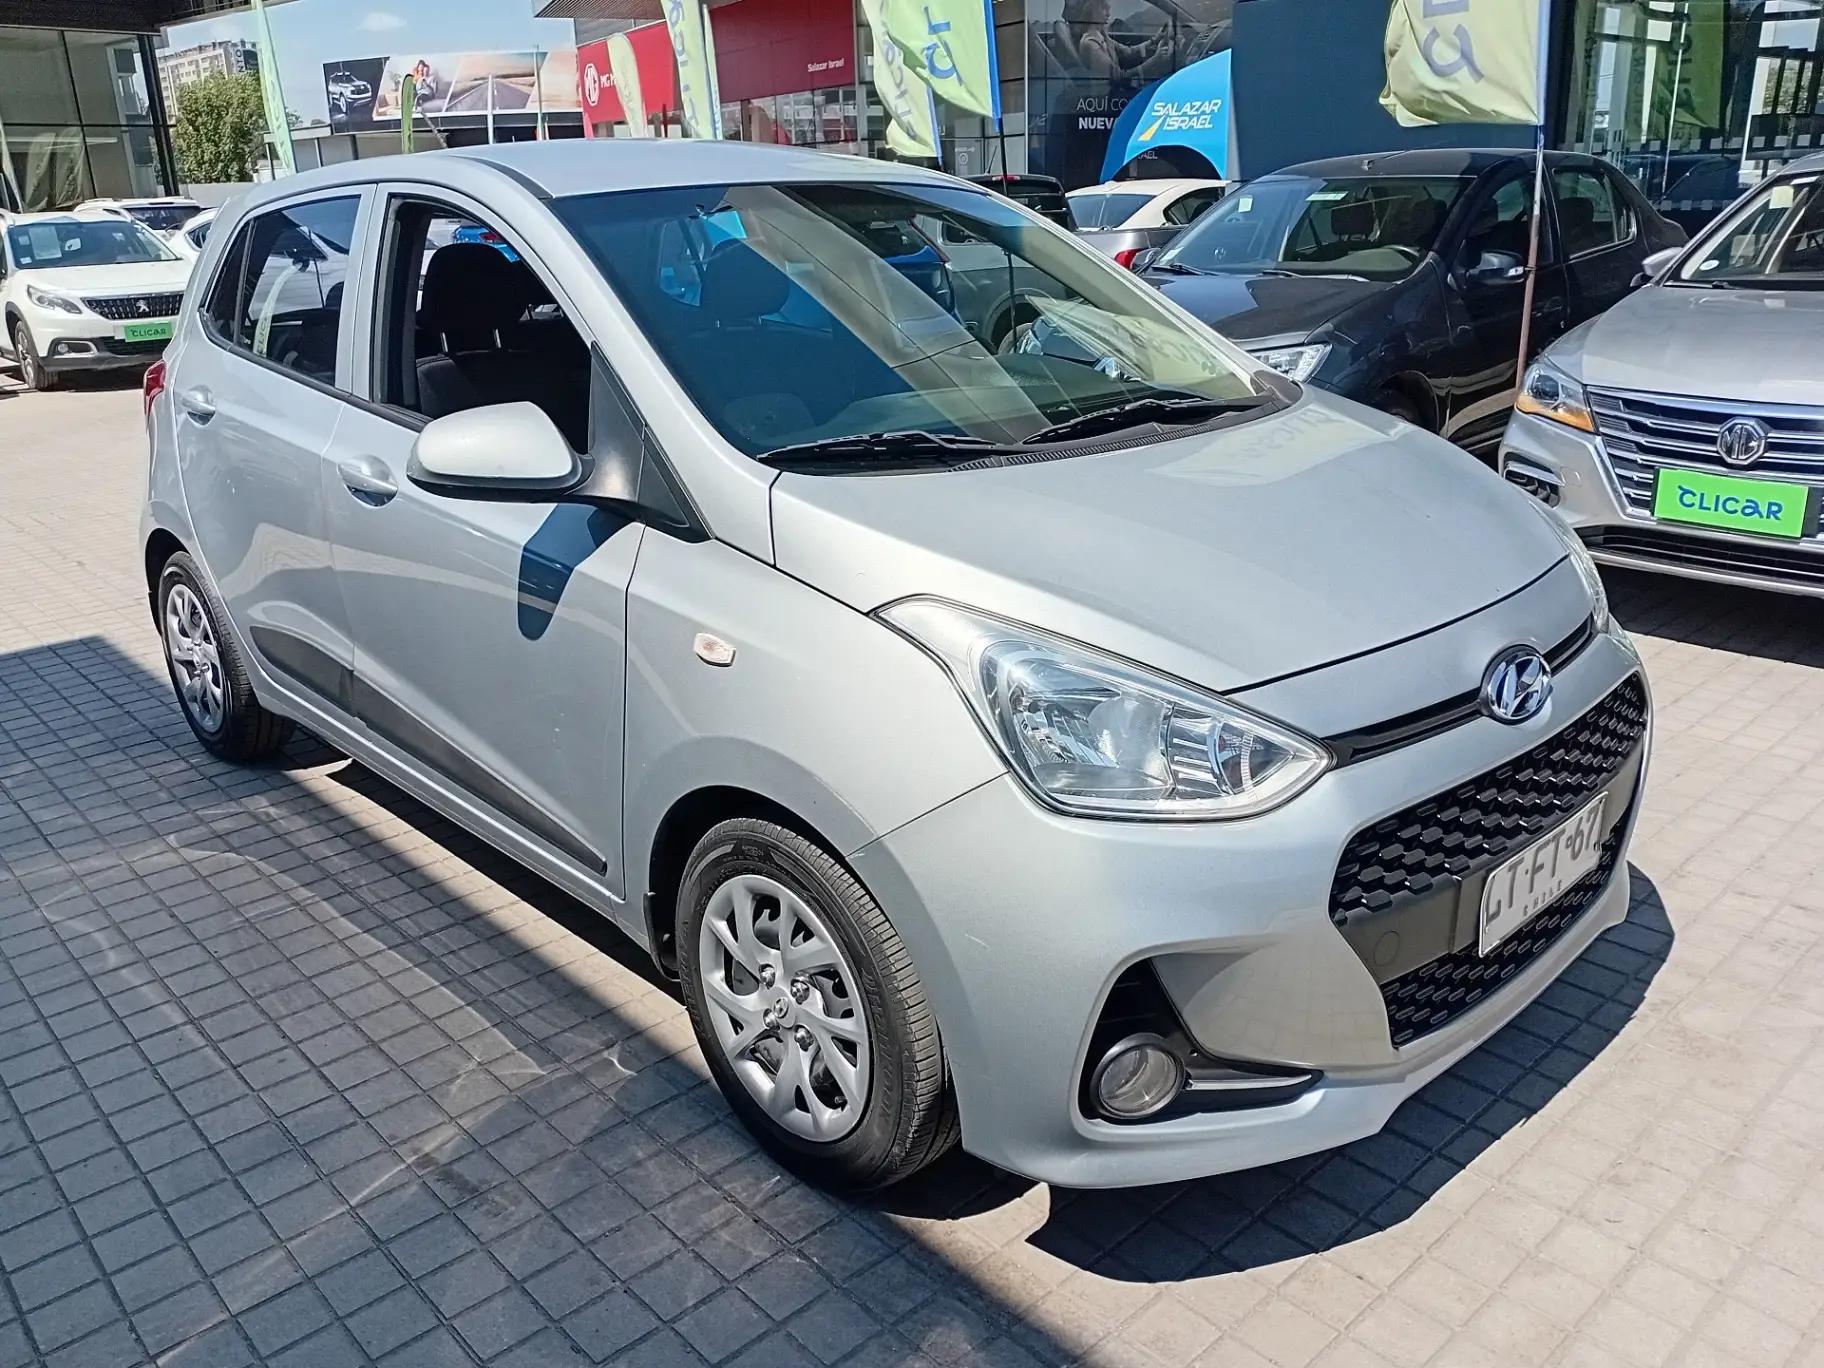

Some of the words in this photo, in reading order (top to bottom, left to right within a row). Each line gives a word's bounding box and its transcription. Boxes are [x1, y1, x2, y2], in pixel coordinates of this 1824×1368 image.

[1077, 96, 1109, 112] AQUÍ
[1151, 99, 1221, 115] SALAZAR
[1078, 117, 1116, 130] NUEV
[1163, 115, 1213, 130] ISRAEL
[1720, 422, 1762, 462] MG
